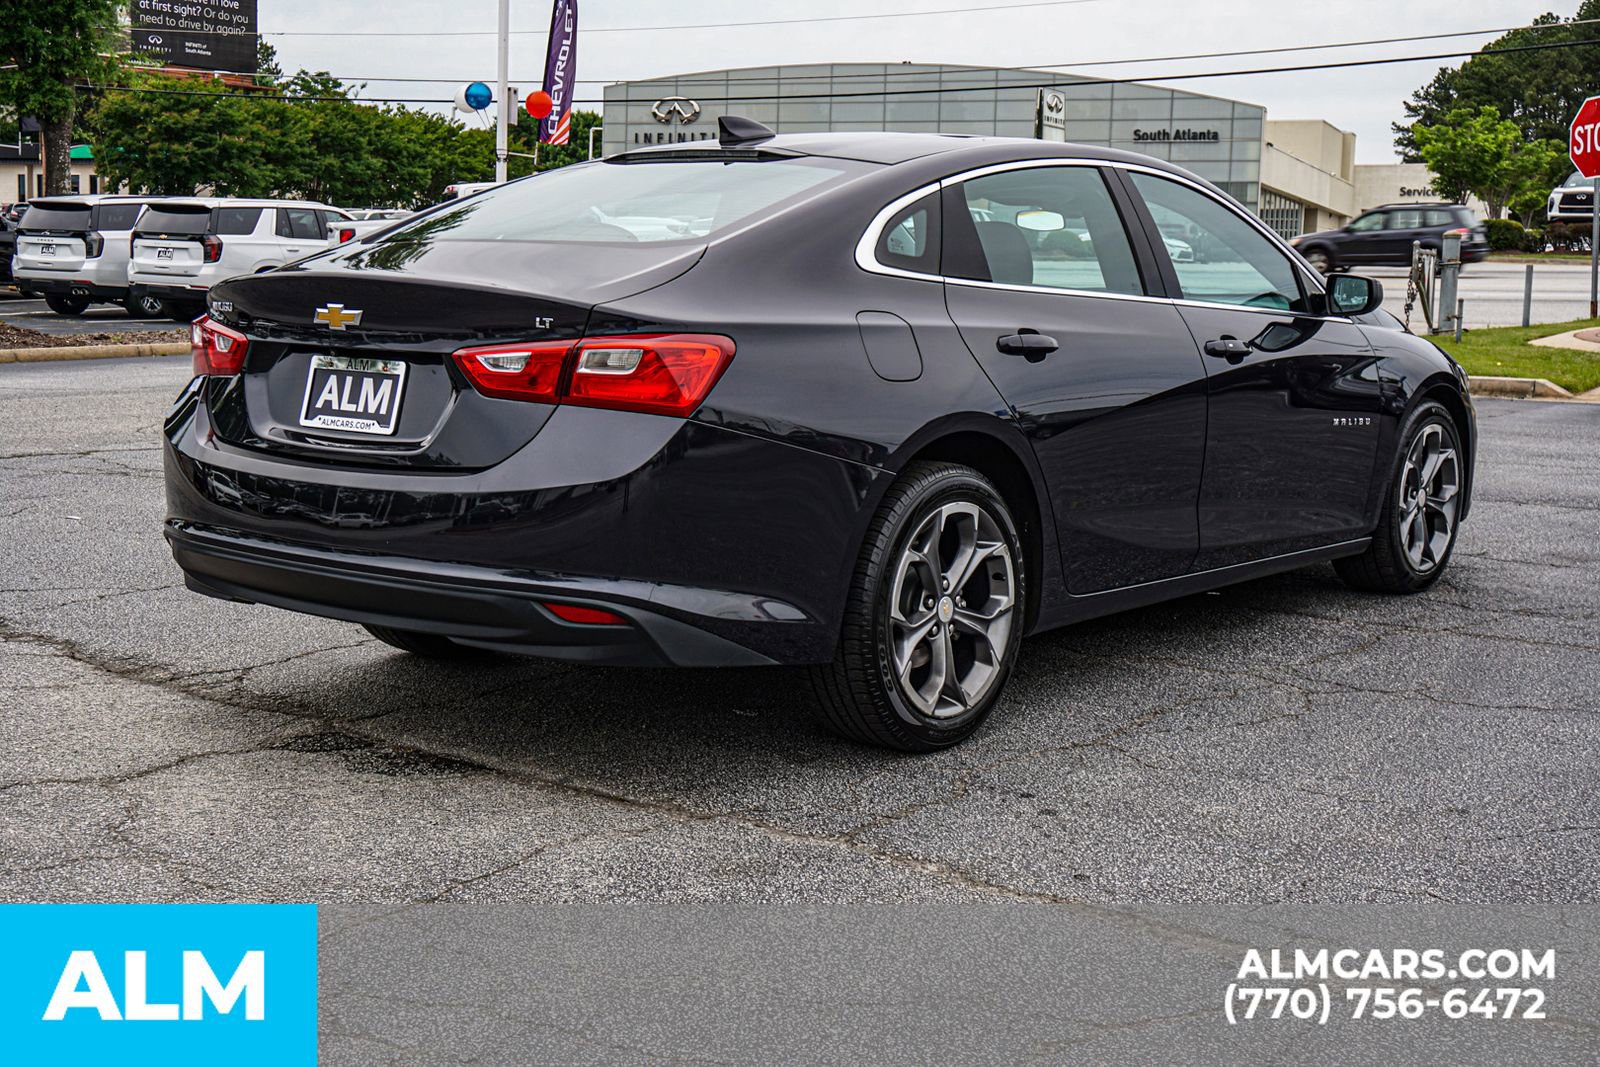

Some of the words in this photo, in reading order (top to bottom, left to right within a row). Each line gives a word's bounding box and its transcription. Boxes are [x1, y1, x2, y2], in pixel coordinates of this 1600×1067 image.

[221, 0, 240, 9] love
[139, 0, 150, 9] at
[153, 0, 172, 12] first
[174, 3, 202, 17] sight?
[204, 7, 216, 18] Or
[218, 10, 230, 20] do
[232, 14, 249, 24] you
[140, 14, 164, 25] need
[166, 17, 176, 26] to
[178, 18, 201, 30] drive
[203, 21, 215, 34] by
[217, 25, 246, 36] again?
[547, 4, 573, 135] CHEVROLET
[634, 132, 716, 144] INFINITI
[1133, 128, 1170, 141] South
[1173, 128, 1219, 141] Atlanta
[1573, 123, 1600, 155] STO
[535, 317, 554, 329] LT
[346, 359, 370, 371] ALM
[315, 374, 393, 415] ALM
[320, 418, 372, 430] ALMCARS.COM
[1333, 417, 1370, 426] MALIBU
